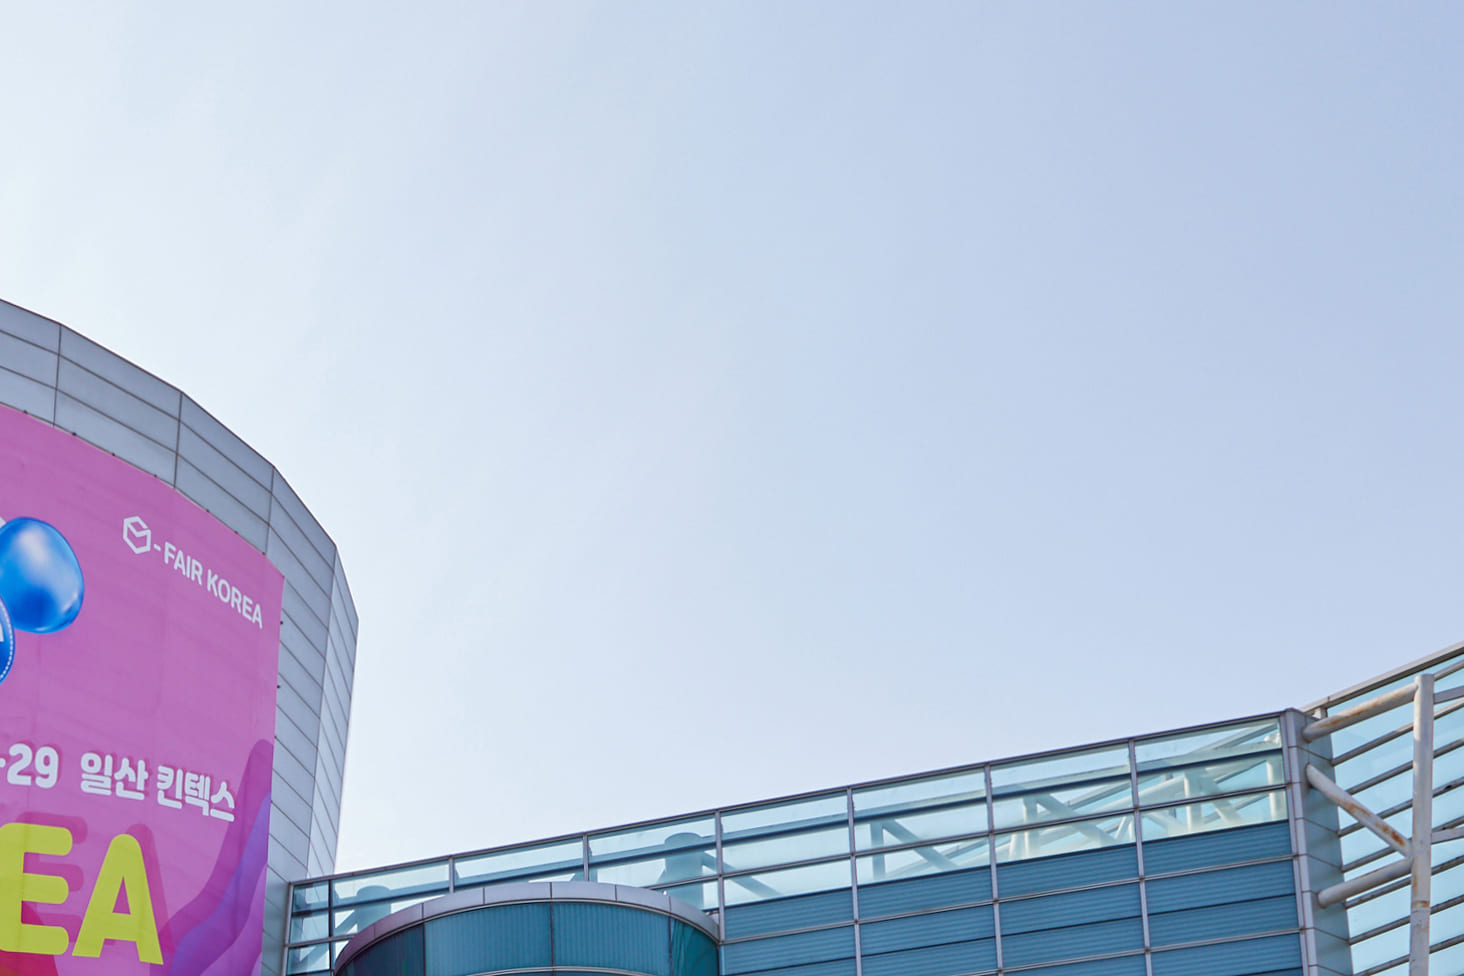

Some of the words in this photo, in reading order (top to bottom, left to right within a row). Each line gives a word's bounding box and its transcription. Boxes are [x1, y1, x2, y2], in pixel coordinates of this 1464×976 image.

[206, 568, 263, 629] KOREA
[80, 752, 149, 801] 일산
[156, 765, 236, 822] 킨텍스
